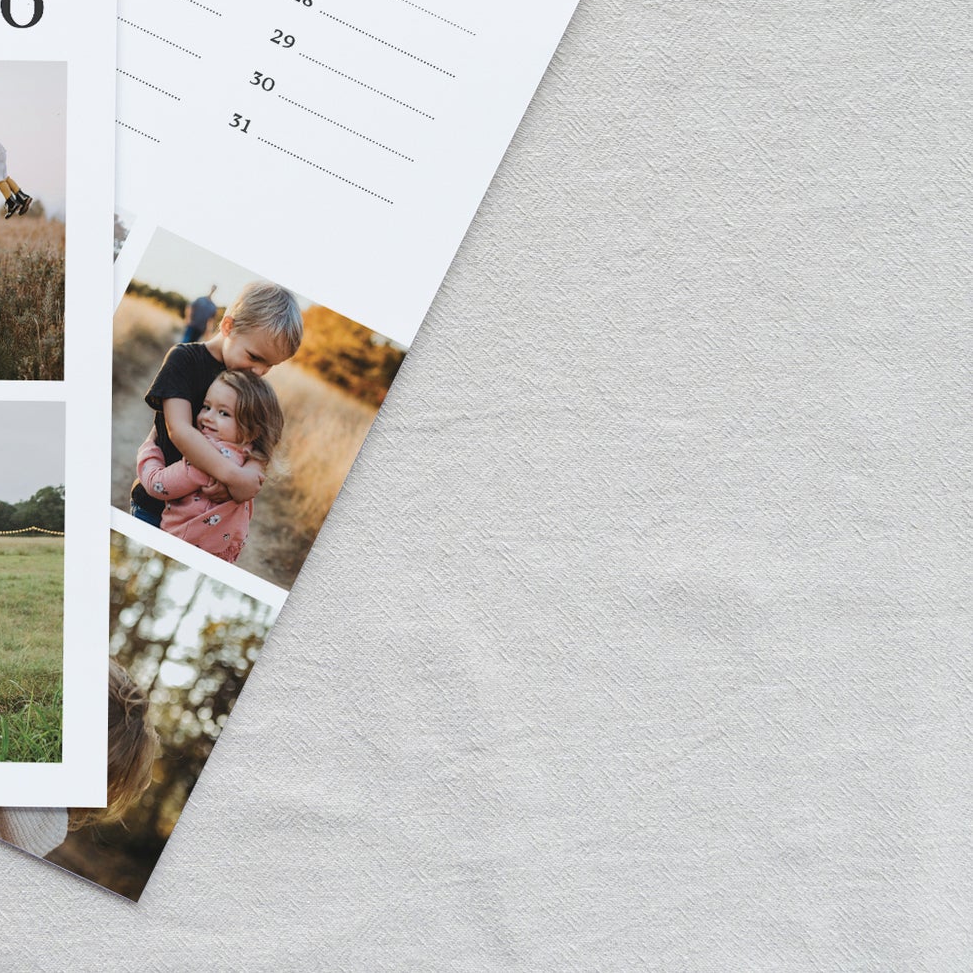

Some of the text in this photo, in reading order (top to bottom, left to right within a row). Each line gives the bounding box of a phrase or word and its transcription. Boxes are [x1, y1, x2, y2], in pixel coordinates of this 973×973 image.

[269, 28, 296, 49] 29
[249, 70, 276, 92] 30
[228, 112, 251, 134] 31
